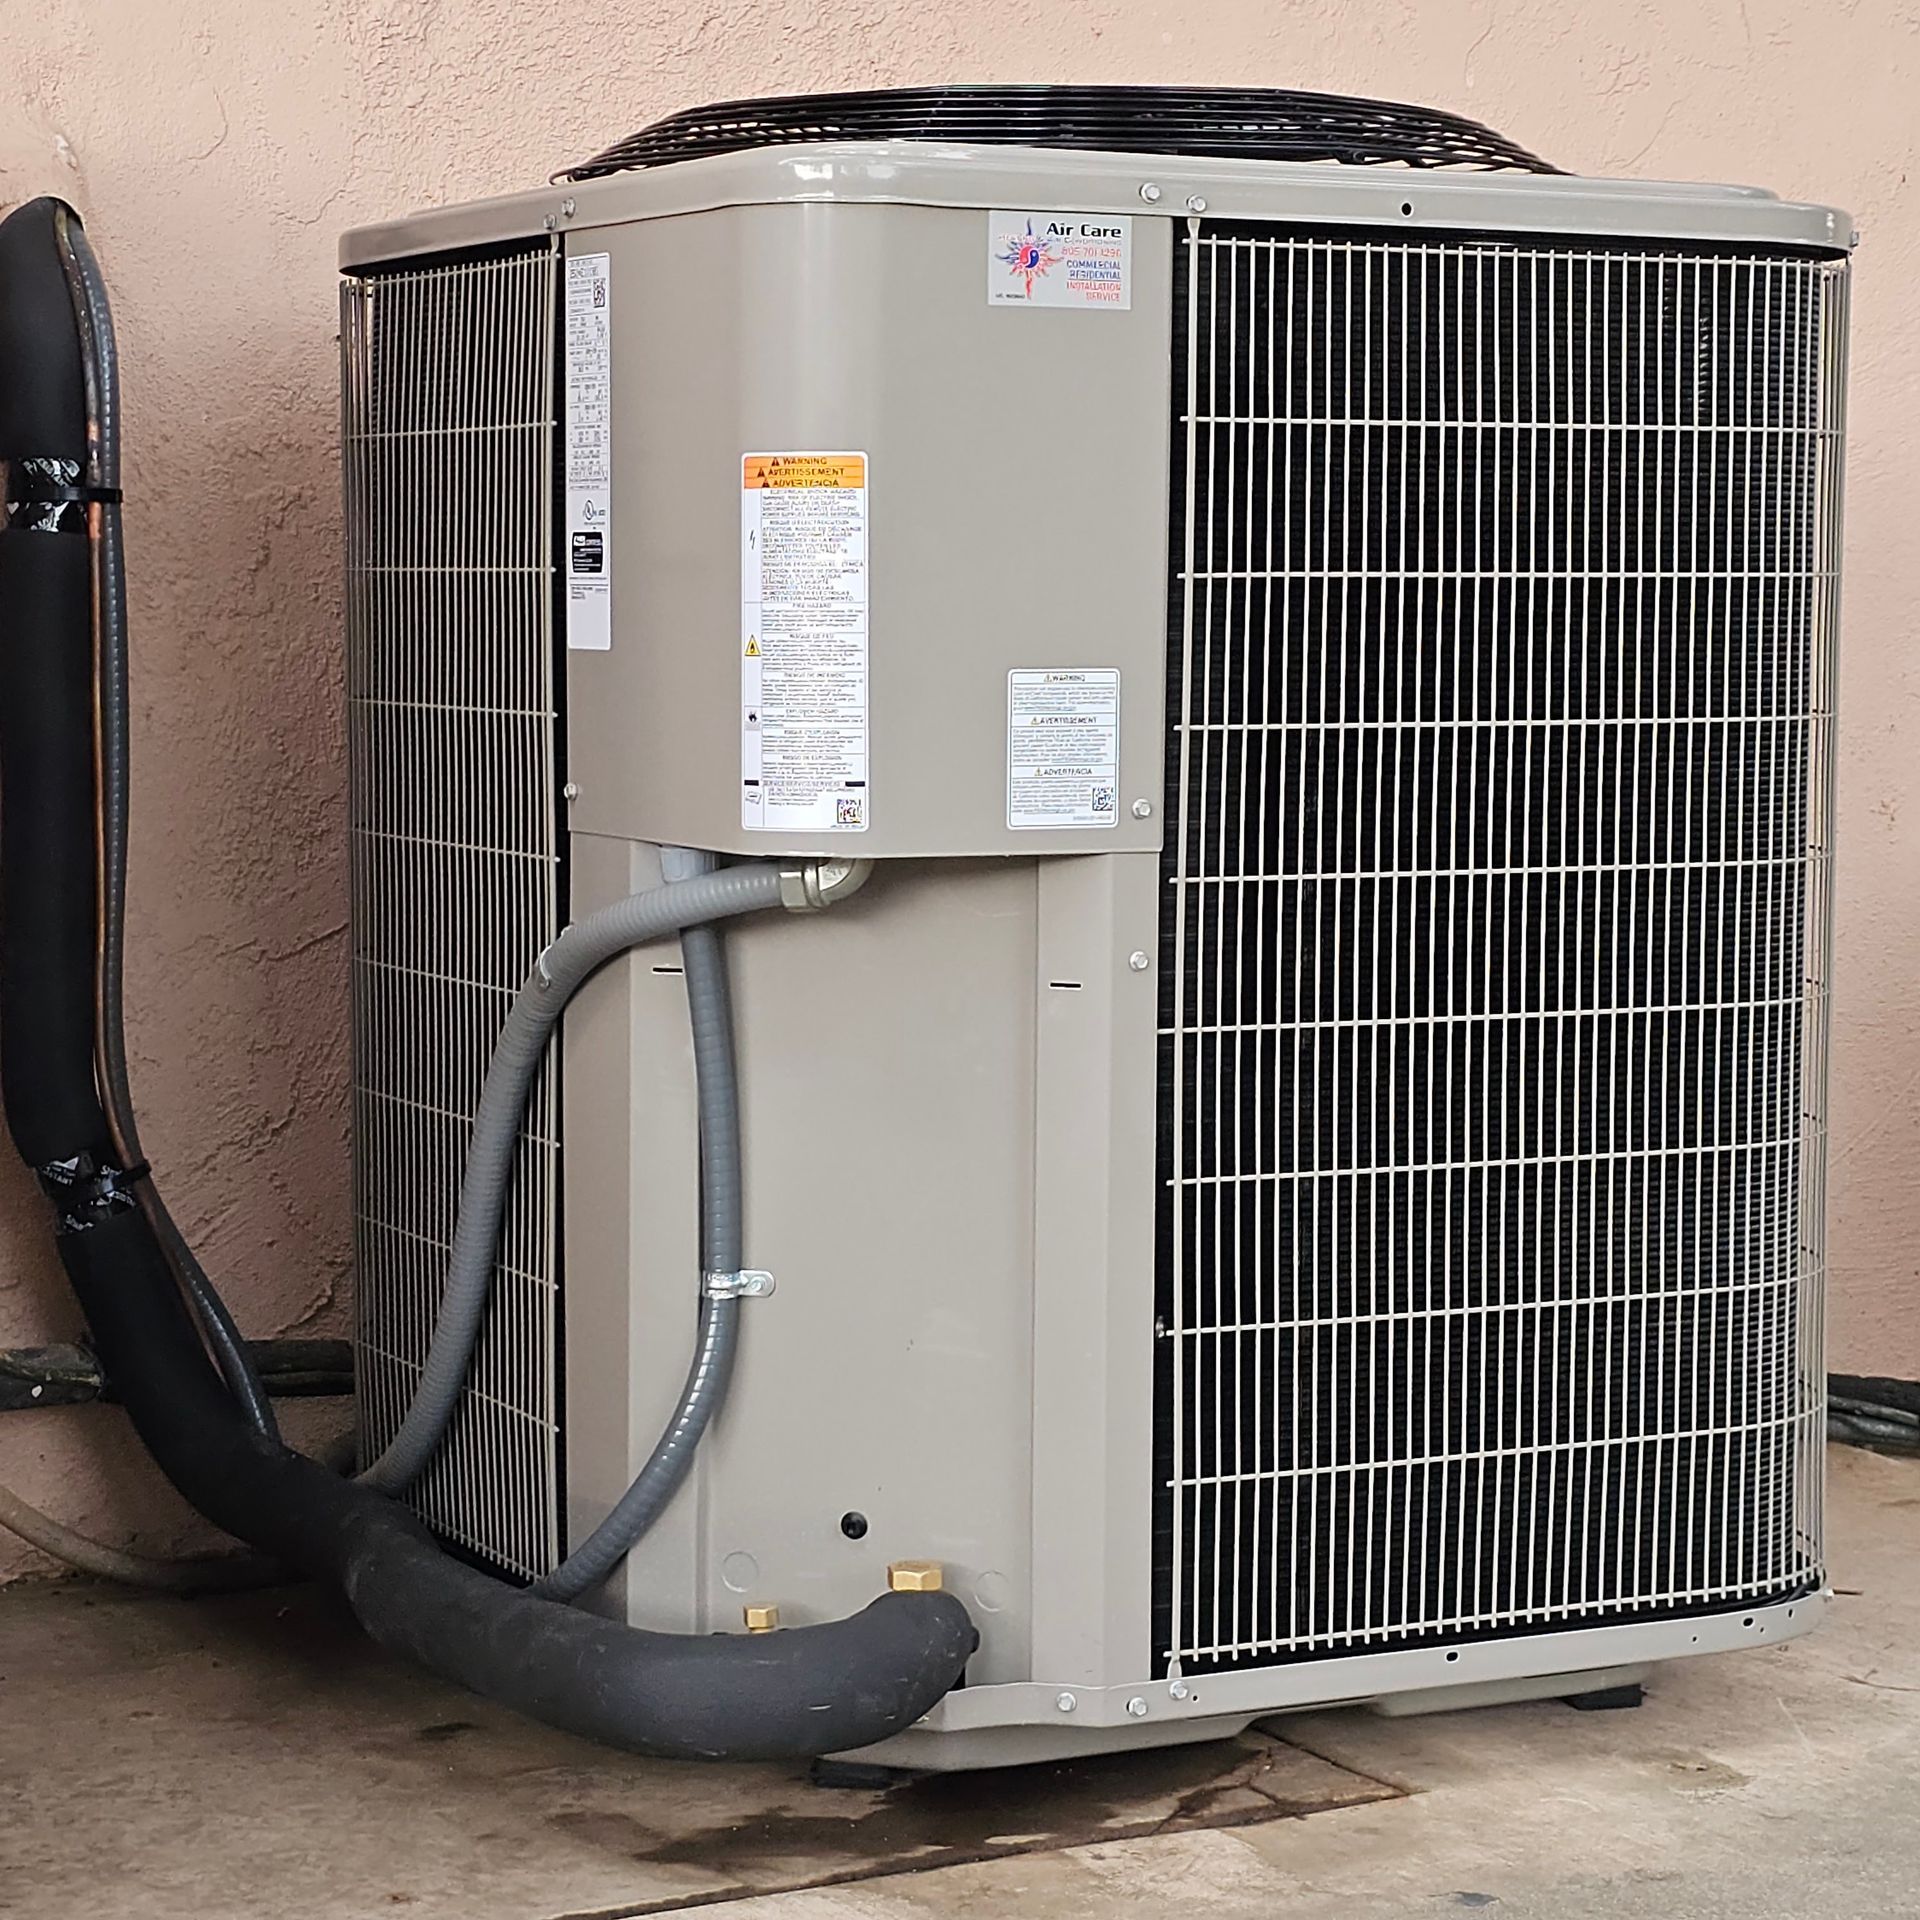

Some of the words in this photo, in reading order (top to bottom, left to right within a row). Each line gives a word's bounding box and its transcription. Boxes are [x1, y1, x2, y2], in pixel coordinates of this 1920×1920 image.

[1046, 222, 1074, 236] Air
[1080, 224, 1122, 238] Care
[1066, 260, 1121, 270] COMMERCIAL
[1069, 270, 1121, 280] RESIDENTIAL
[1066, 281, 1121, 292] INSTALLATION
[1086, 291, 1121, 302] SERVICE
[783, 457, 828, 465] WARNING
[768, 467, 845, 476] AVERTISSEMENT
[773, 479, 840, 488] ADVERTENCIA
[1053, 674, 1086, 682] WARNING
[1040, 716, 1097, 724] AVERTISSEMENT
[1043, 768, 1093, 776] ADVERTENCIA
